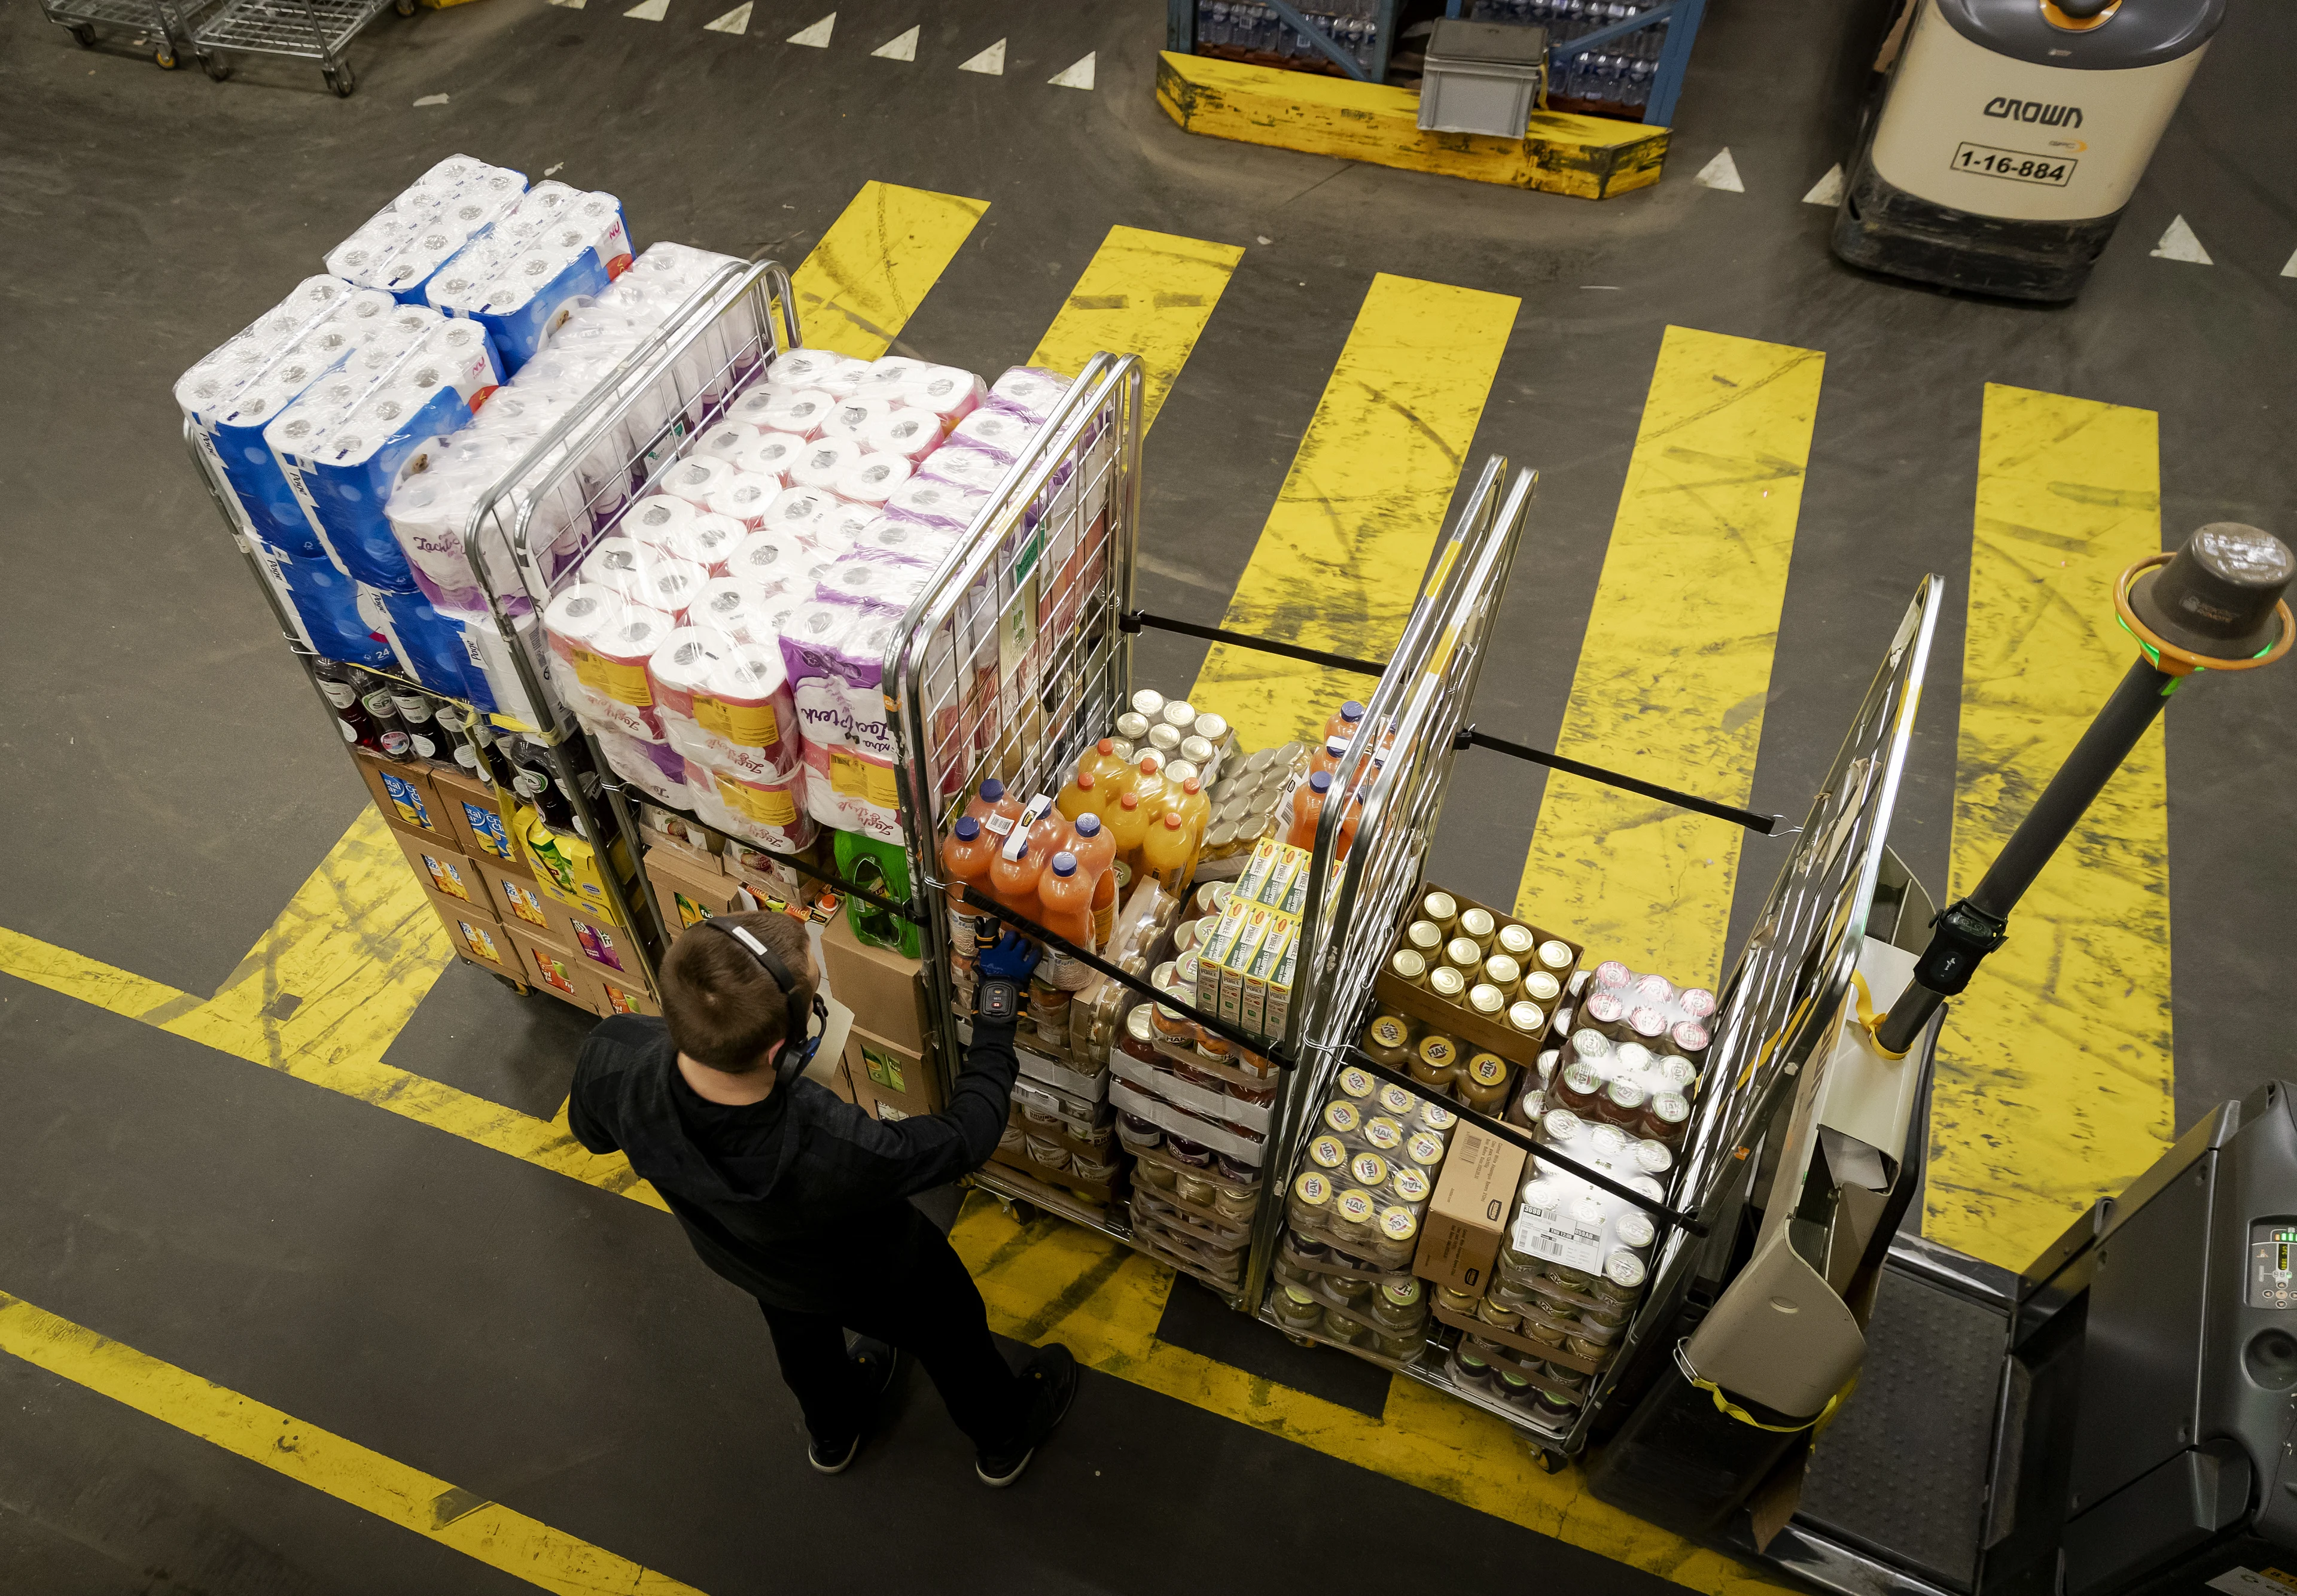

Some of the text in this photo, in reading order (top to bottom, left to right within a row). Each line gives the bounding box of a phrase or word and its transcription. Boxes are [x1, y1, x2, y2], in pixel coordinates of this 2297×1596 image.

[1984, 96, 2083, 129] CROWN
[1961, 150, 2066, 181] 1-16-884
[609, 221, 620, 240] NU
[200, 432, 217, 456] Page
[290, 472, 307, 497] Page
[267, 559, 283, 581] Page
[371, 593, 386, 614] Page
[376, 648, 389, 659] 24
[467, 640, 482, 661] Page
[862, 740, 896, 753] xtra
[870, 813, 880, 823] &
[1245, 875, 1256, 897] STAMPPOT
[1268, 881, 1278, 904] STAMPPOT
[1290, 889, 1301, 912] STAMPPOT
[811, 913, 826, 922] JUMBO
[1213, 936, 1224, 960] STAMPPOT
[1236, 943, 1247, 968] STAMPPOT
[1259, 951, 1270, 976] STAMPPOT
[1281, 958, 1293, 984] STAMPPOT
[1223, 1052, 1235, 1061] HA
[1427, 1044, 1449, 1059] HAK
[1482, 1059, 1496, 1079] HAK
[1348, 1072, 1366, 1091] HAK
[1389, 1089, 1407, 1107] HAK
[1333, 1107, 1351, 1125] HAK
[1372, 1126, 1394, 1139] HAK
[1321, 1142, 1337, 1161] HAK
[1362, 1159, 1375, 1178] HAK
[1309, 1178, 1318, 1198] HAK
[1402, 1179, 1422, 1190] HAK
[1346, 1199, 1367, 1213] HAK
[1524, 1205, 1542, 1216] 3698
